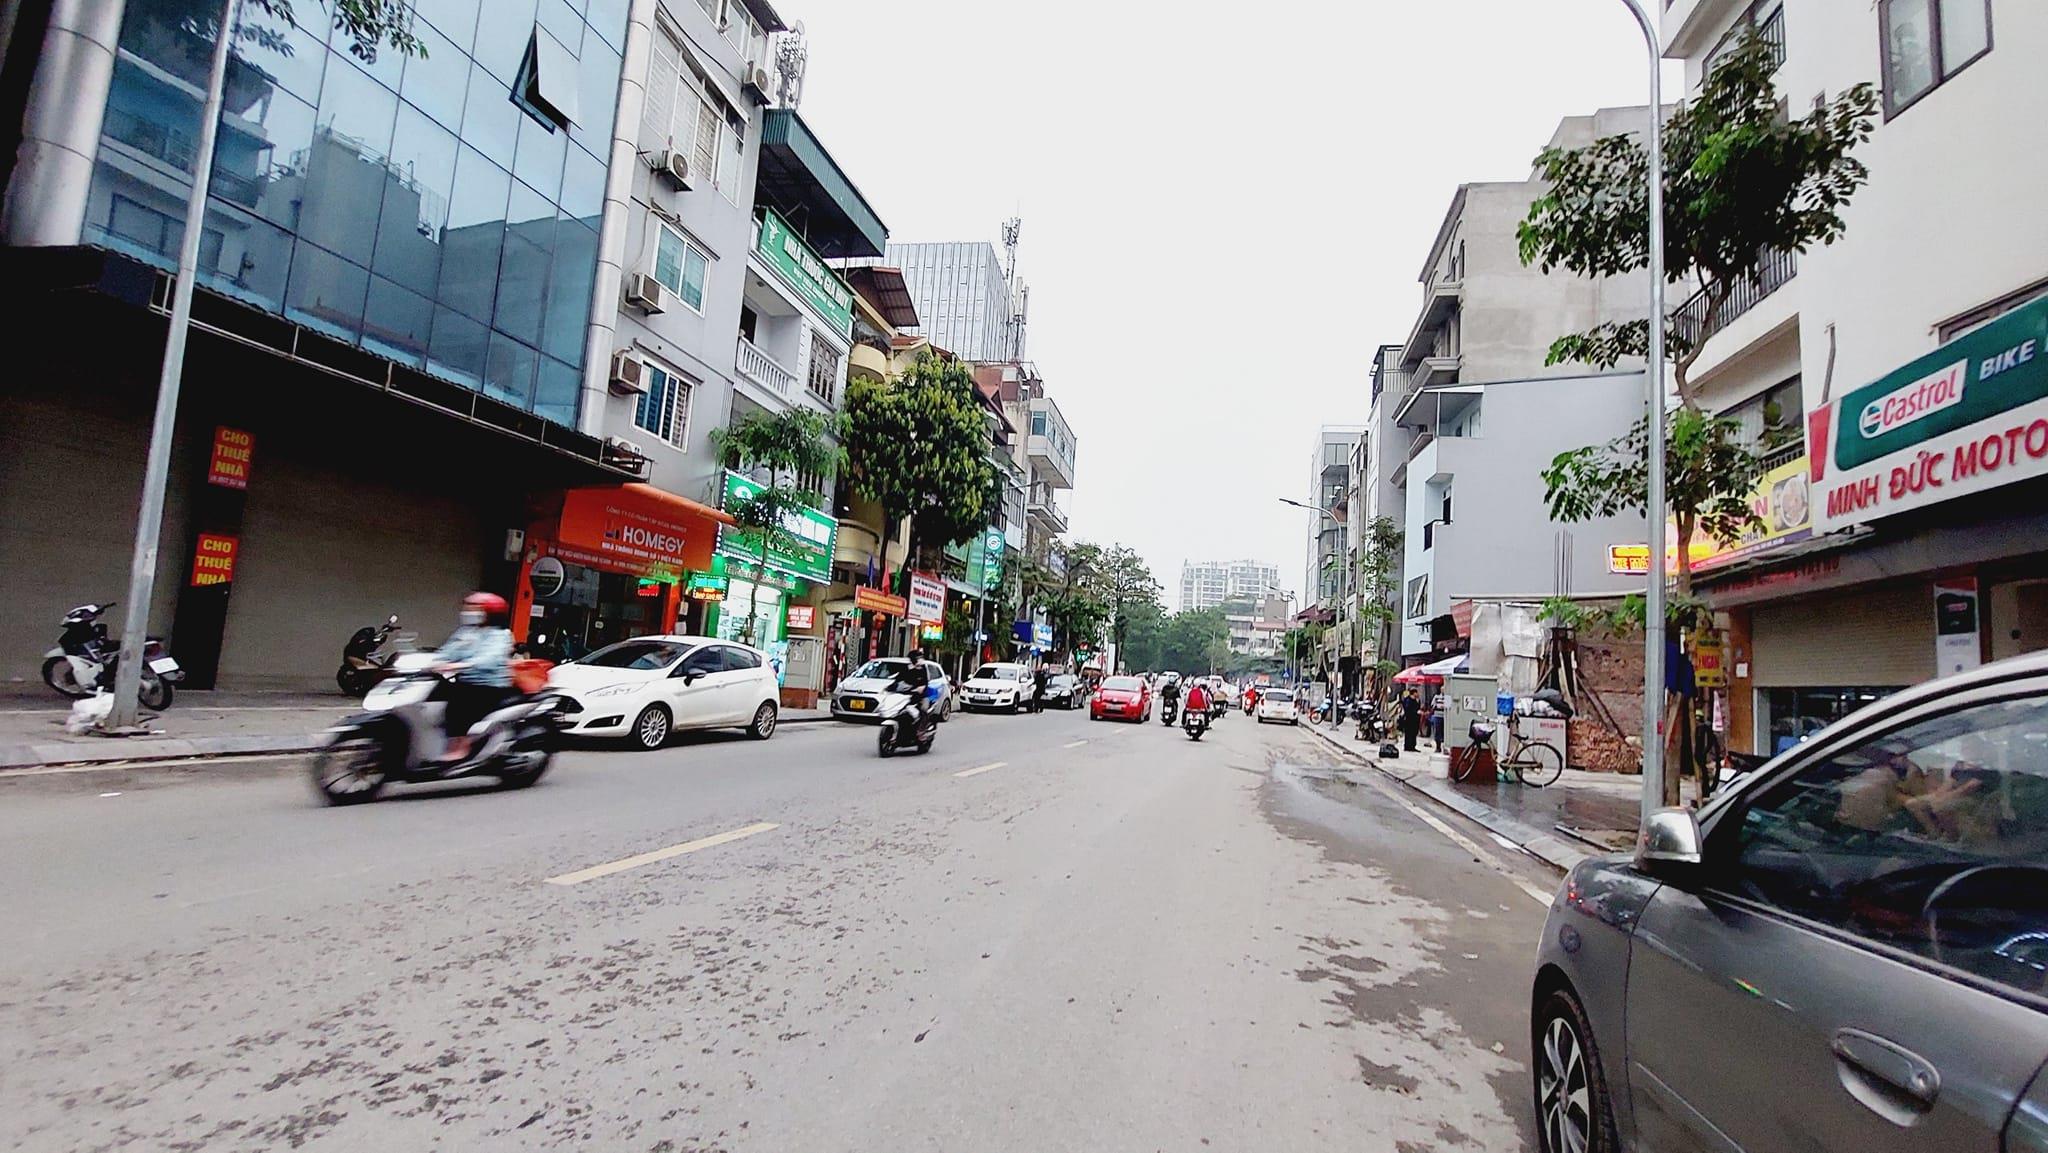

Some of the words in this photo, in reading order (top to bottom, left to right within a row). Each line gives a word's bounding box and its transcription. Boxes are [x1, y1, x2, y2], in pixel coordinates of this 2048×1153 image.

[1882, 369, 1957, 427] Castrol
[1979, 338, 2037, 381] BIKE
[222, 429, 249, 446] CHO
[216, 443, 250, 462] THUÊ
[1827, 475, 1880, 519] MINH
[1889, 451, 1946, 500] ĐỨC
[203, 539, 232, 553] CHO
[623, 525, 685, 555] HOMEGY
[196, 554, 232, 570] THUÊ
